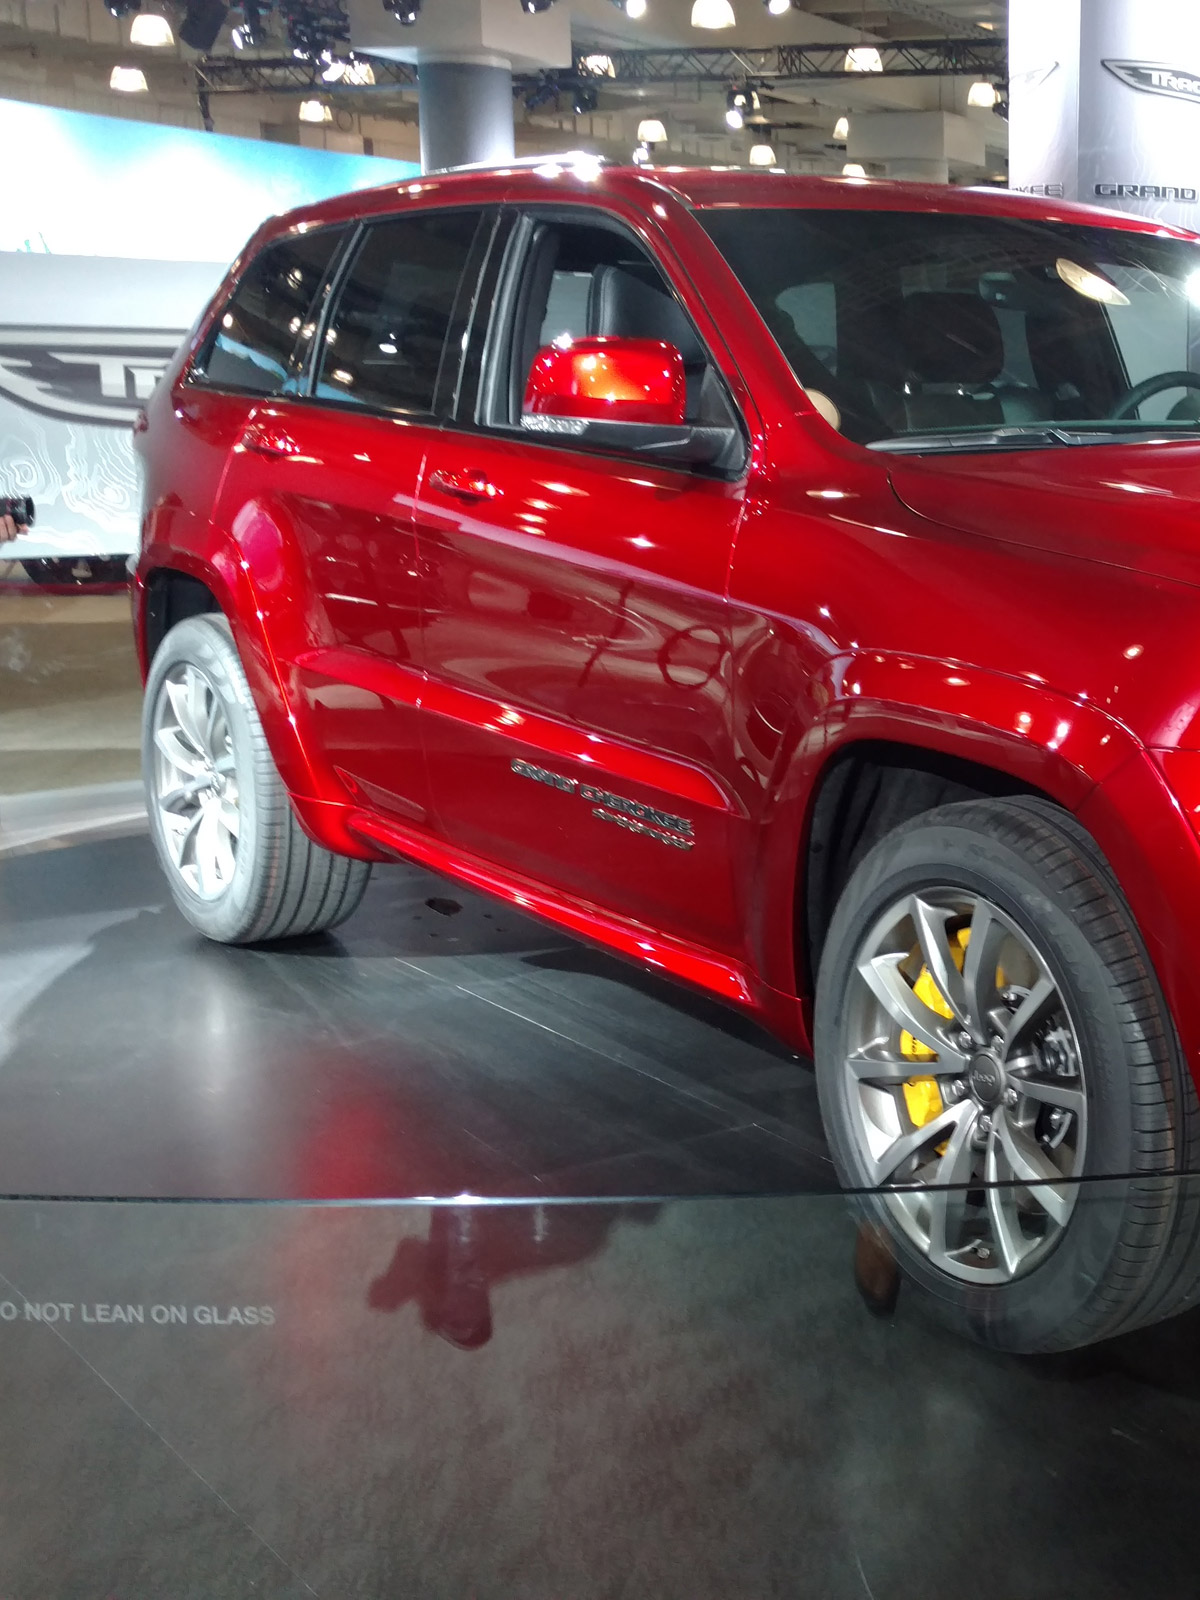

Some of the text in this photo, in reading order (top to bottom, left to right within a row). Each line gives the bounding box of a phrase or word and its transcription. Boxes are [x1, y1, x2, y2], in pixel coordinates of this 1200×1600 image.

[1094, 182, 1198, 201] GRAND
[511, 758, 578, 794] GRAND
[580, 783, 695, 836] CHEROKEE
[0, 1300, 276, 1326] O NOT LEAN ON GLASS
